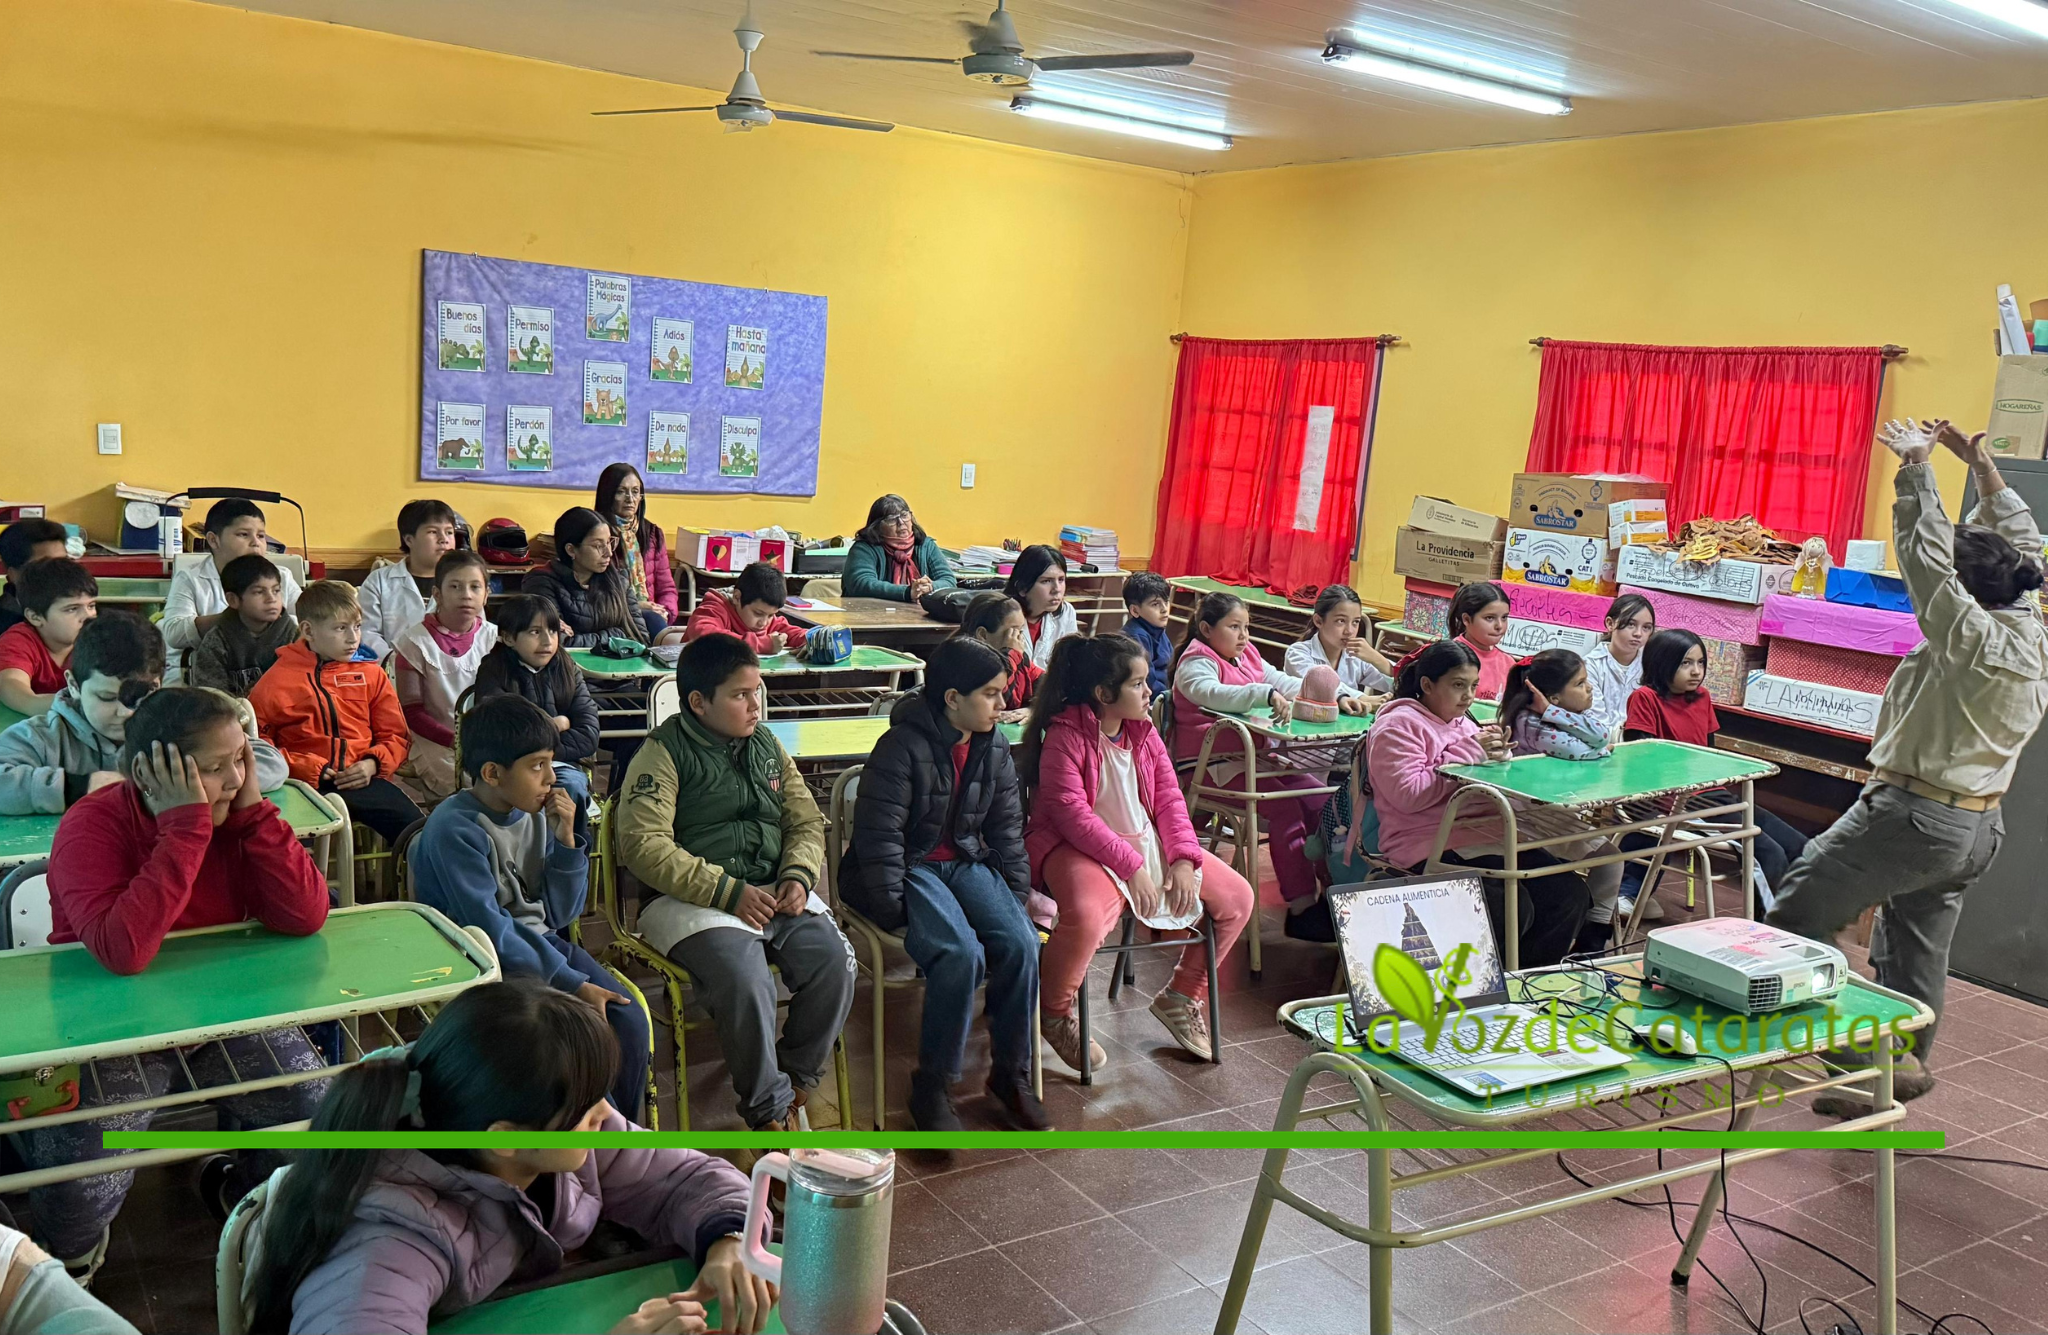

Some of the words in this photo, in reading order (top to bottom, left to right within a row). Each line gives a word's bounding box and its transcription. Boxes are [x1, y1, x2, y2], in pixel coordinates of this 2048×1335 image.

[595, 279, 627, 291] Palabras
[596, 290, 625, 303] Mágicas
[446, 308, 477, 321] Buenos
[464, 323, 482, 334] días
[515, 319, 550, 331] Permiso
[663, 329, 685, 341] Adiós
[735, 326, 762, 340] Hasta
[731, 341, 766, 354] mañana
[591, 372, 623, 384] Gracias
[445, 415, 460, 425] Por
[461, 417, 482, 426] favor
[514, 418, 545, 430] Perdón
[655, 421, 665, 431] De
[667, 423, 686, 432] nada
[727, 424, 758, 437] Disculpa
[1536, 515, 1574, 528] SABROSTAR
[1416, 540, 1426, 552] La
[1428, 542, 1475, 559] Providencia
[1428, 557, 1460, 567] GALLETITAS
[1577, 564, 1590, 572] CAT
[1526, 573, 1567, 586] SABROSTAR
[1625, 572, 1647, 581] Pescado
[1647, 576, 1674, 585] Congelado
[1681, 581, 1700, 589] Cultivo
[1366, 894, 1401, 906] CADENA
[1402, 887, 1451, 902] ALIMENTICIA
